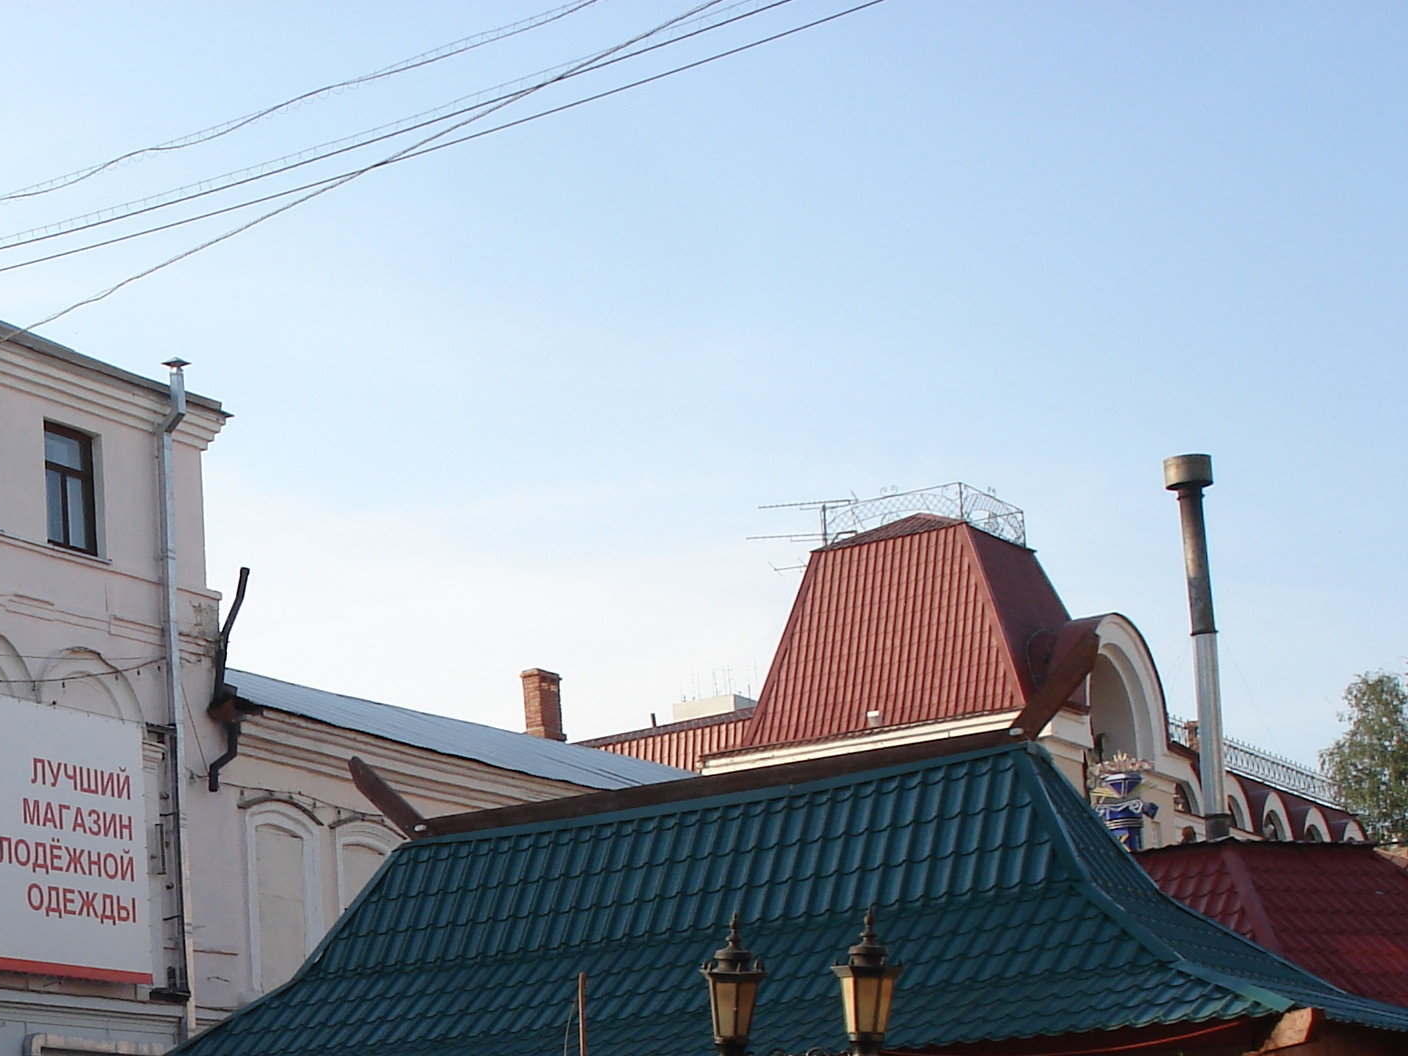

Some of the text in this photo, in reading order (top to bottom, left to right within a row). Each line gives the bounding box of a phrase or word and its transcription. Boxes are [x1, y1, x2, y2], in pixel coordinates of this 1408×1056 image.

[30, 757, 132, 800] ЛУЧШИЙ
[22, 797, 134, 841] МАГАЗИН
[27, 883, 137, 925] ОДЕЖДЫ
